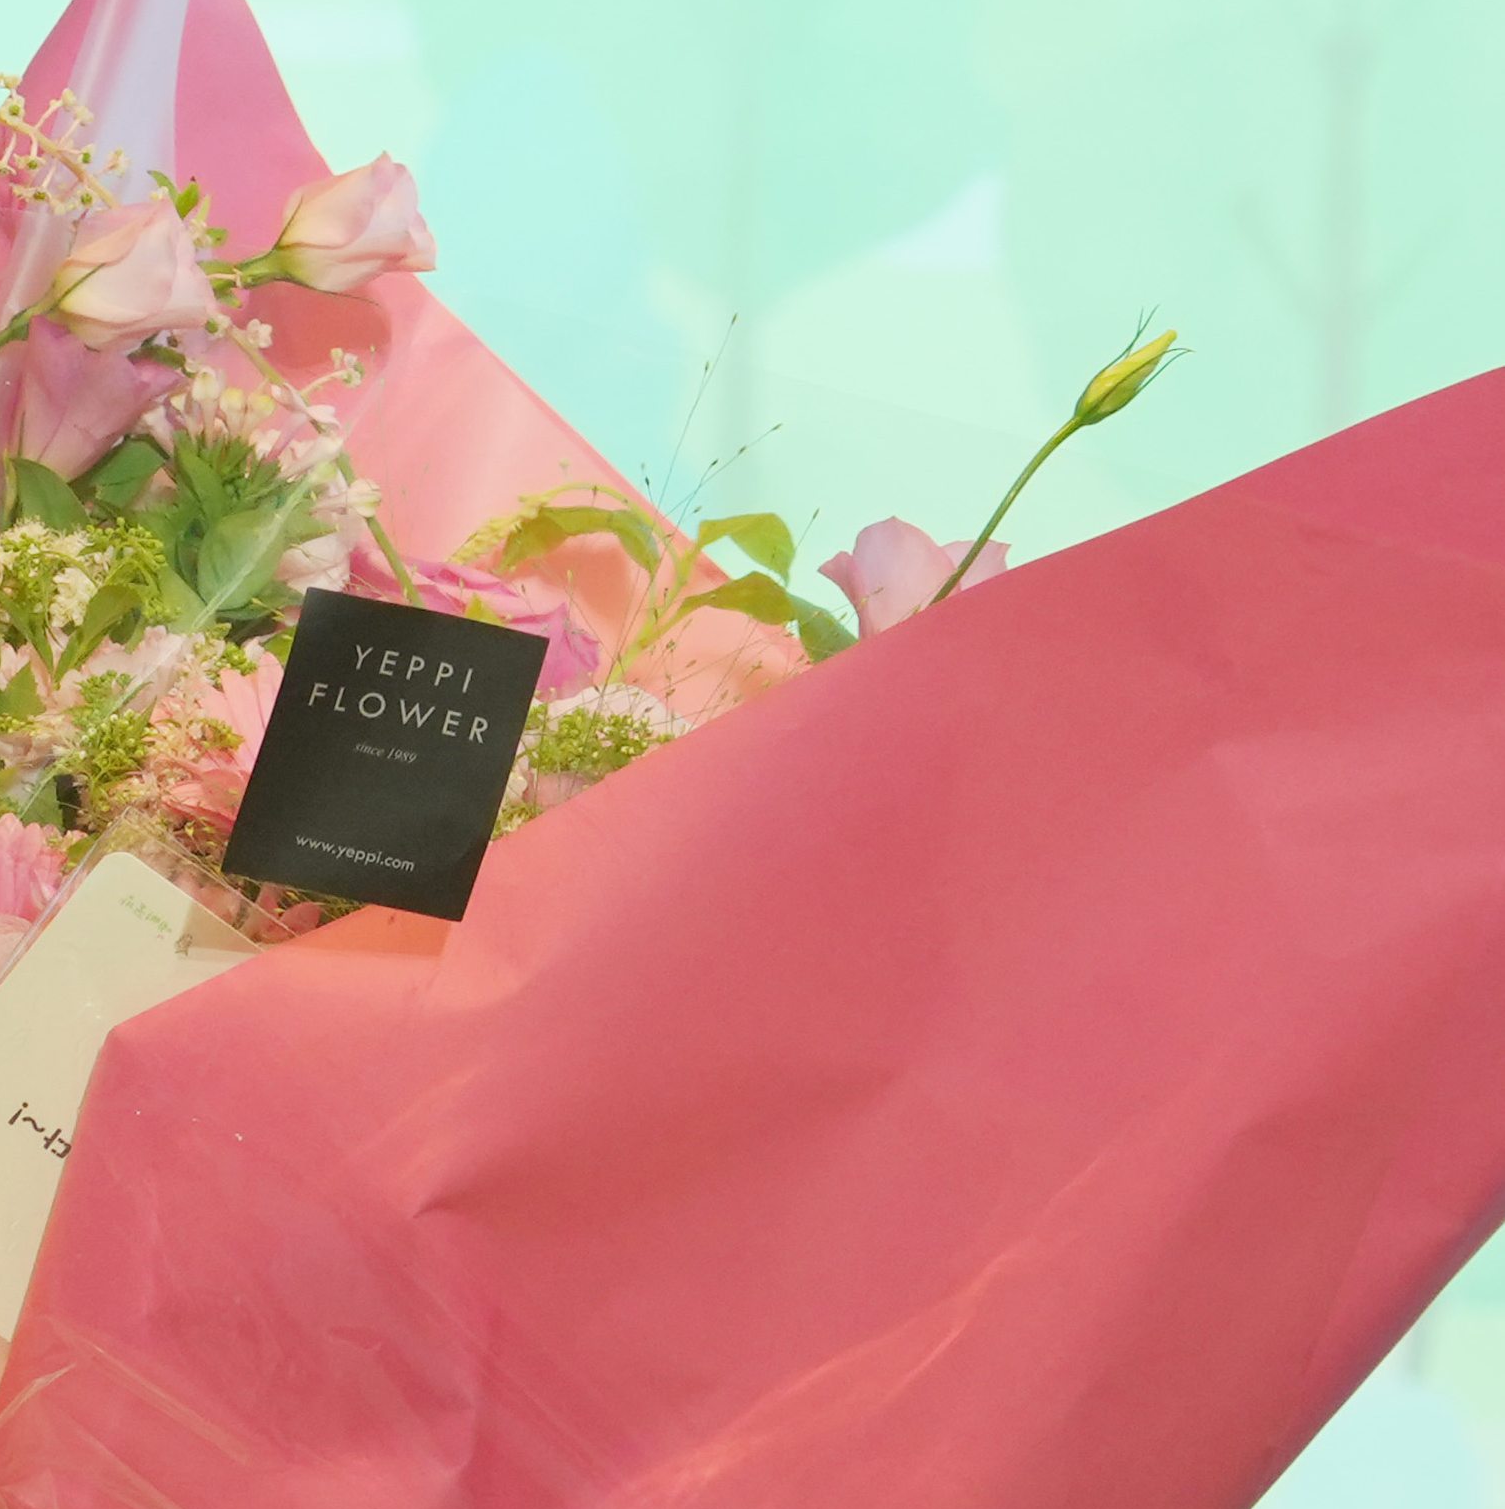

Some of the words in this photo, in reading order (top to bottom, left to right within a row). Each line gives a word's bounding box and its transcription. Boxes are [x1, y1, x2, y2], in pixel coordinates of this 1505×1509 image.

[355, 644, 473, 694] YEPPI
[308, 682, 489, 744] FLOWER
[355, 741, 385, 757] since
[386, 747, 418, 765] 1989
[295, 835, 415, 872] www.yeppi.com
